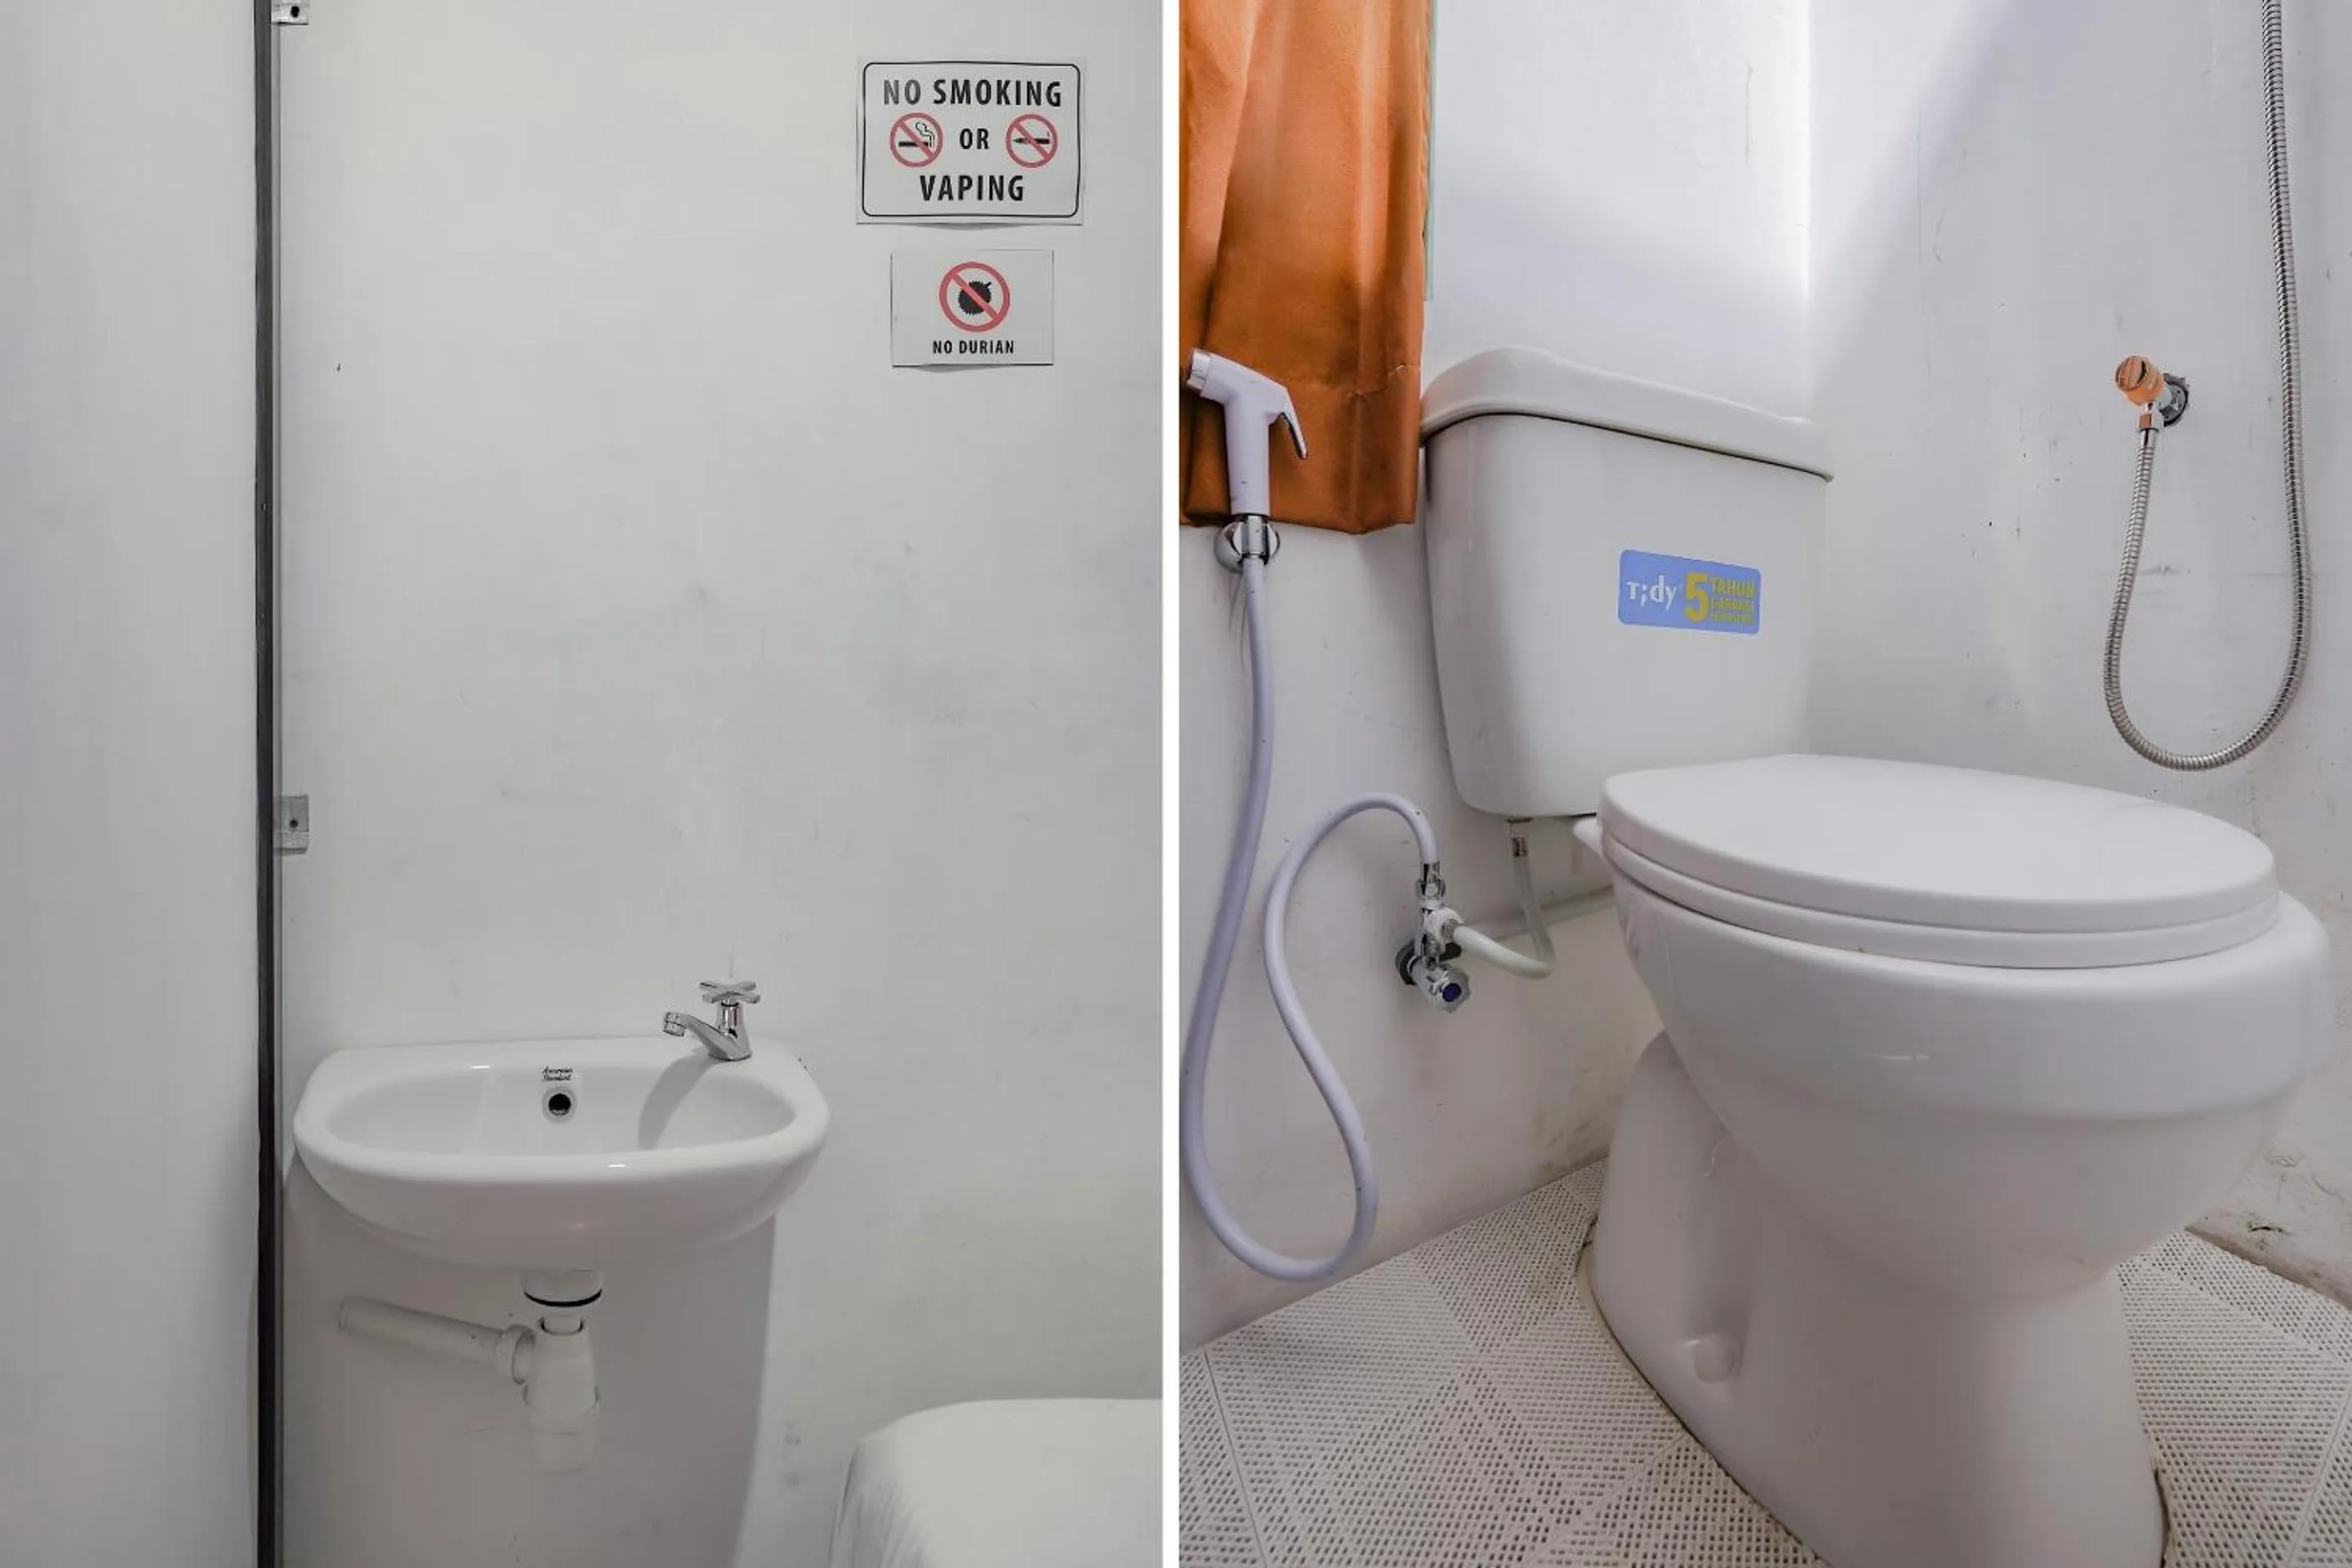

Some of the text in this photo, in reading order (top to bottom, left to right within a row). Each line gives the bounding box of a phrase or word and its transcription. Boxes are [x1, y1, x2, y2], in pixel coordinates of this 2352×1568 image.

[884, 79, 1061, 107] NO SMOKING
[959, 128, 990, 149] OR
[920, 175, 1024, 201] VAPING
[933, 340, 1013, 354] NO DURIAN
[1685, 572, 1708, 622] 5
